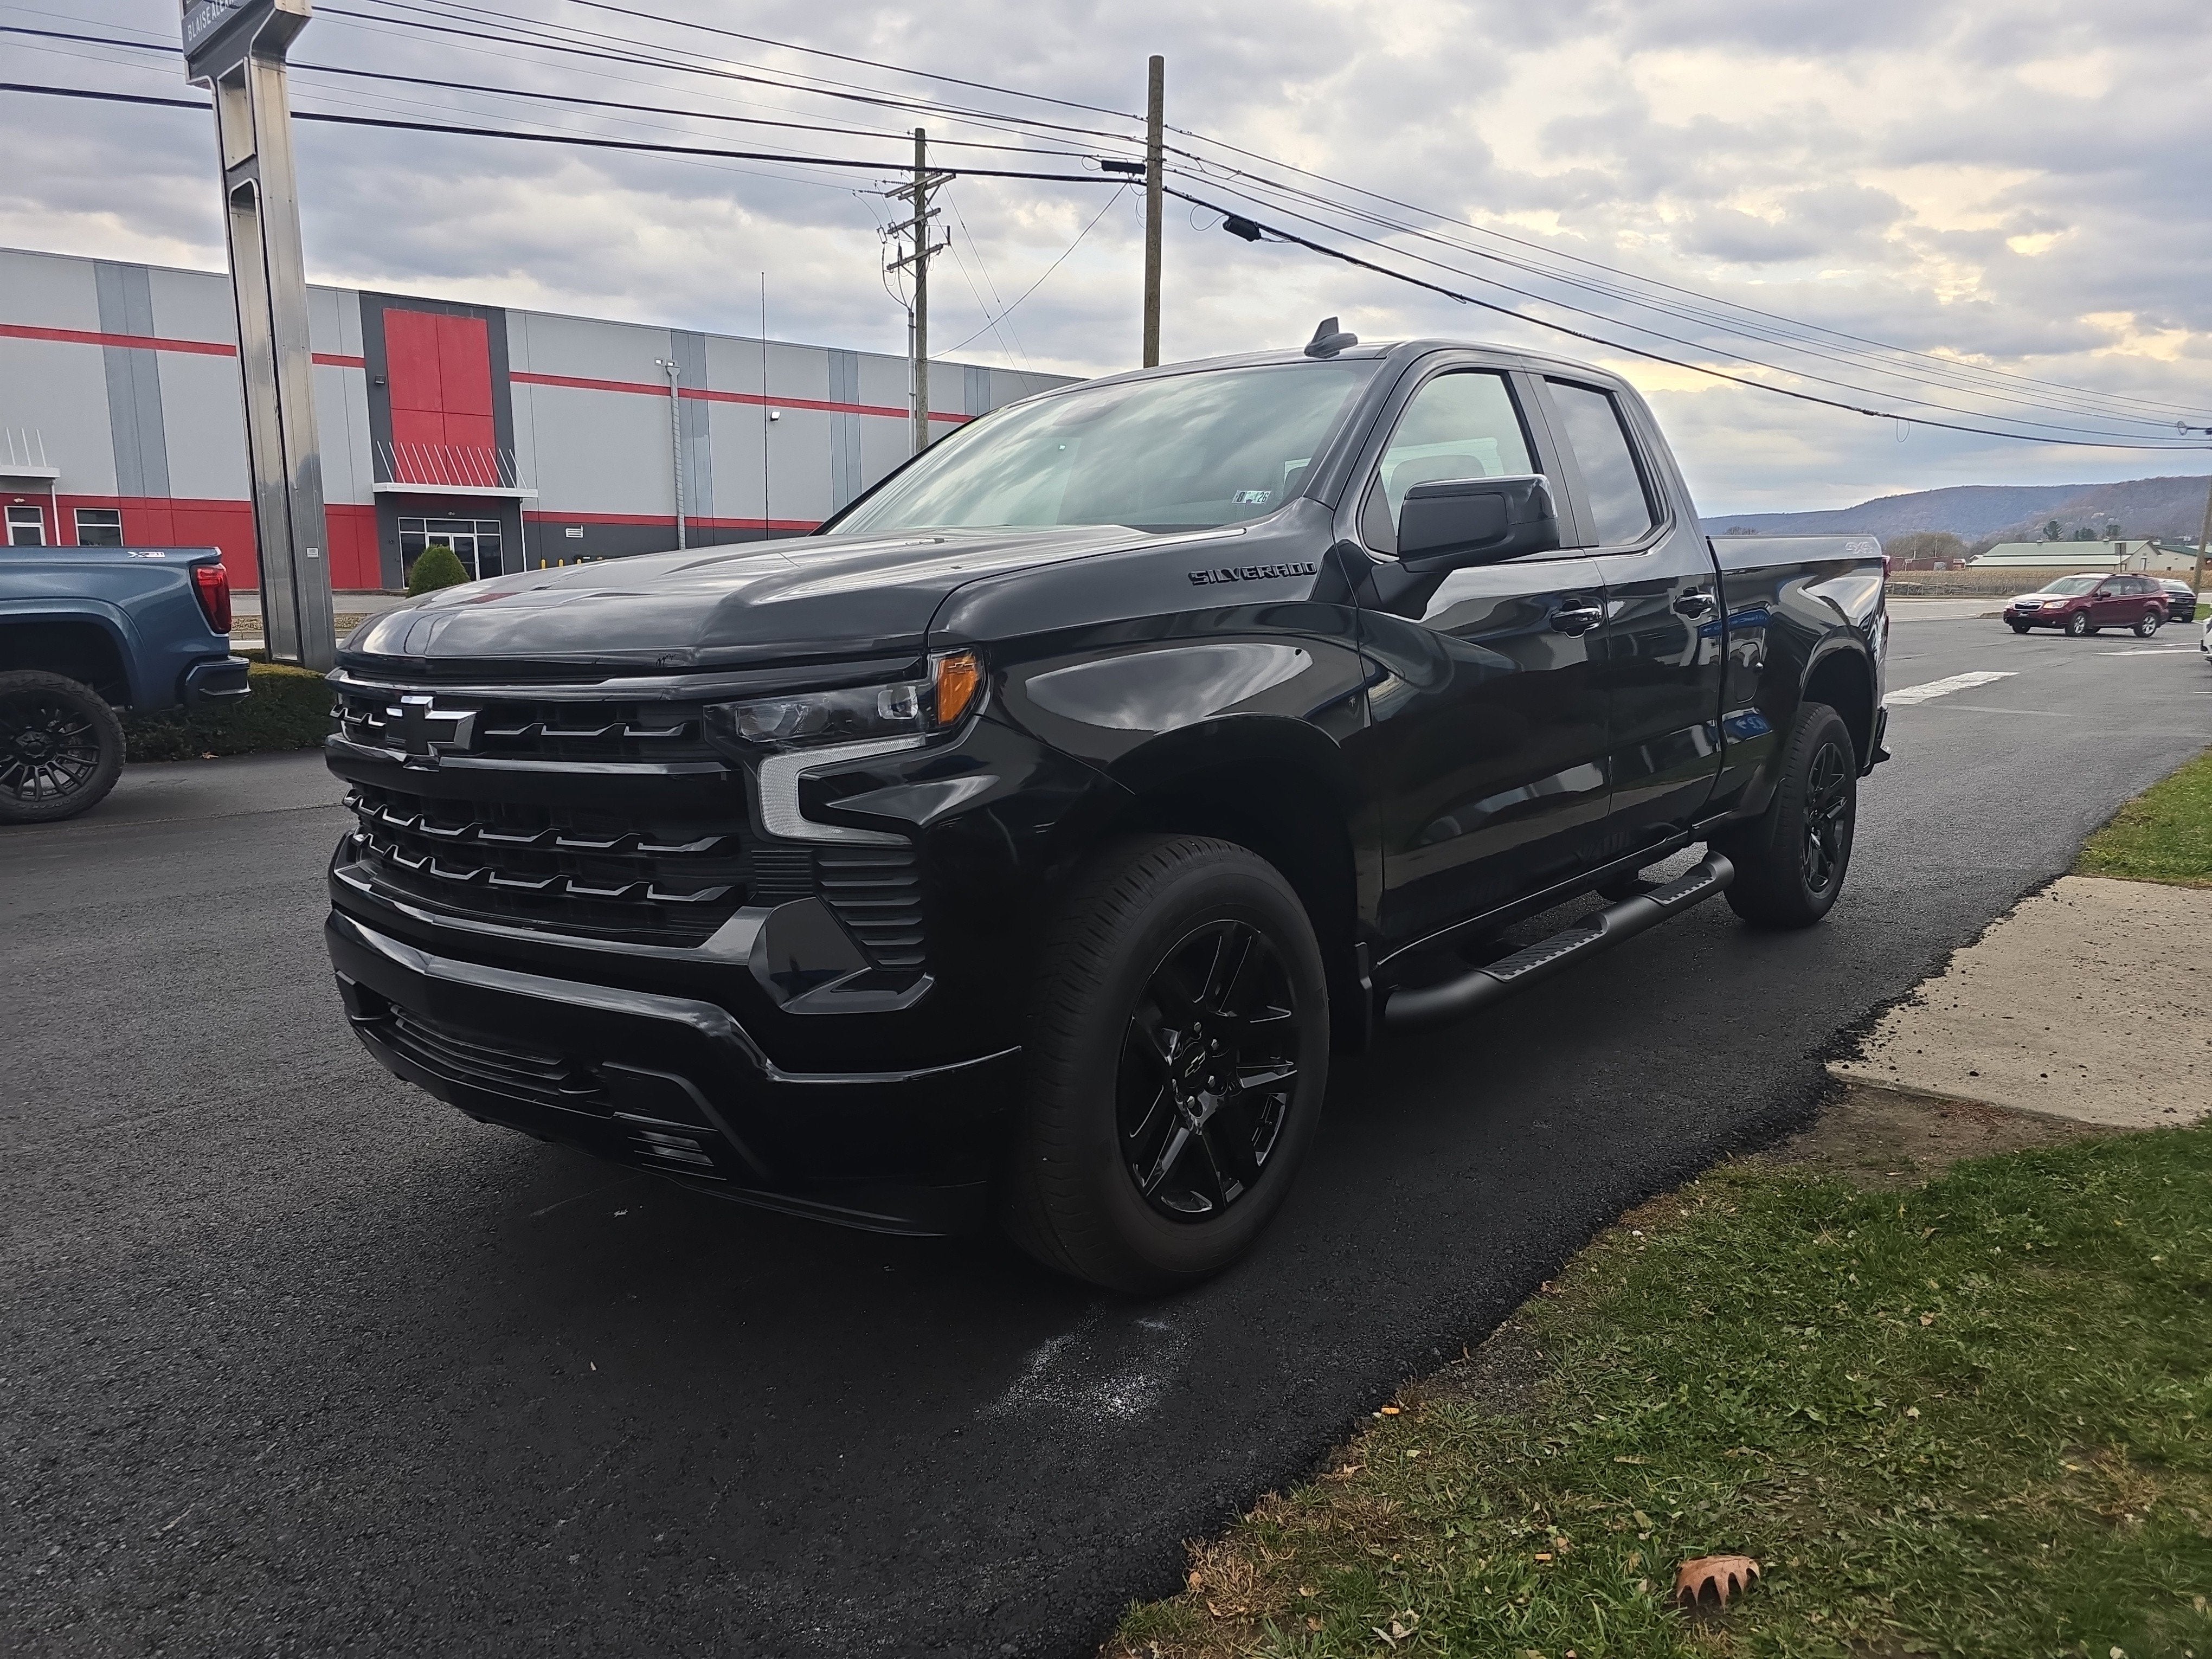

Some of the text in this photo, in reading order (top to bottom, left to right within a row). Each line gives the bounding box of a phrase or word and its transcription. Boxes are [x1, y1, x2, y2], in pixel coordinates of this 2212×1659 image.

[188, 7, 211, 42] BLAISE
[1257, 492, 1269, 502] 26
[1188, 561, 1318, 586] SILVERADO
